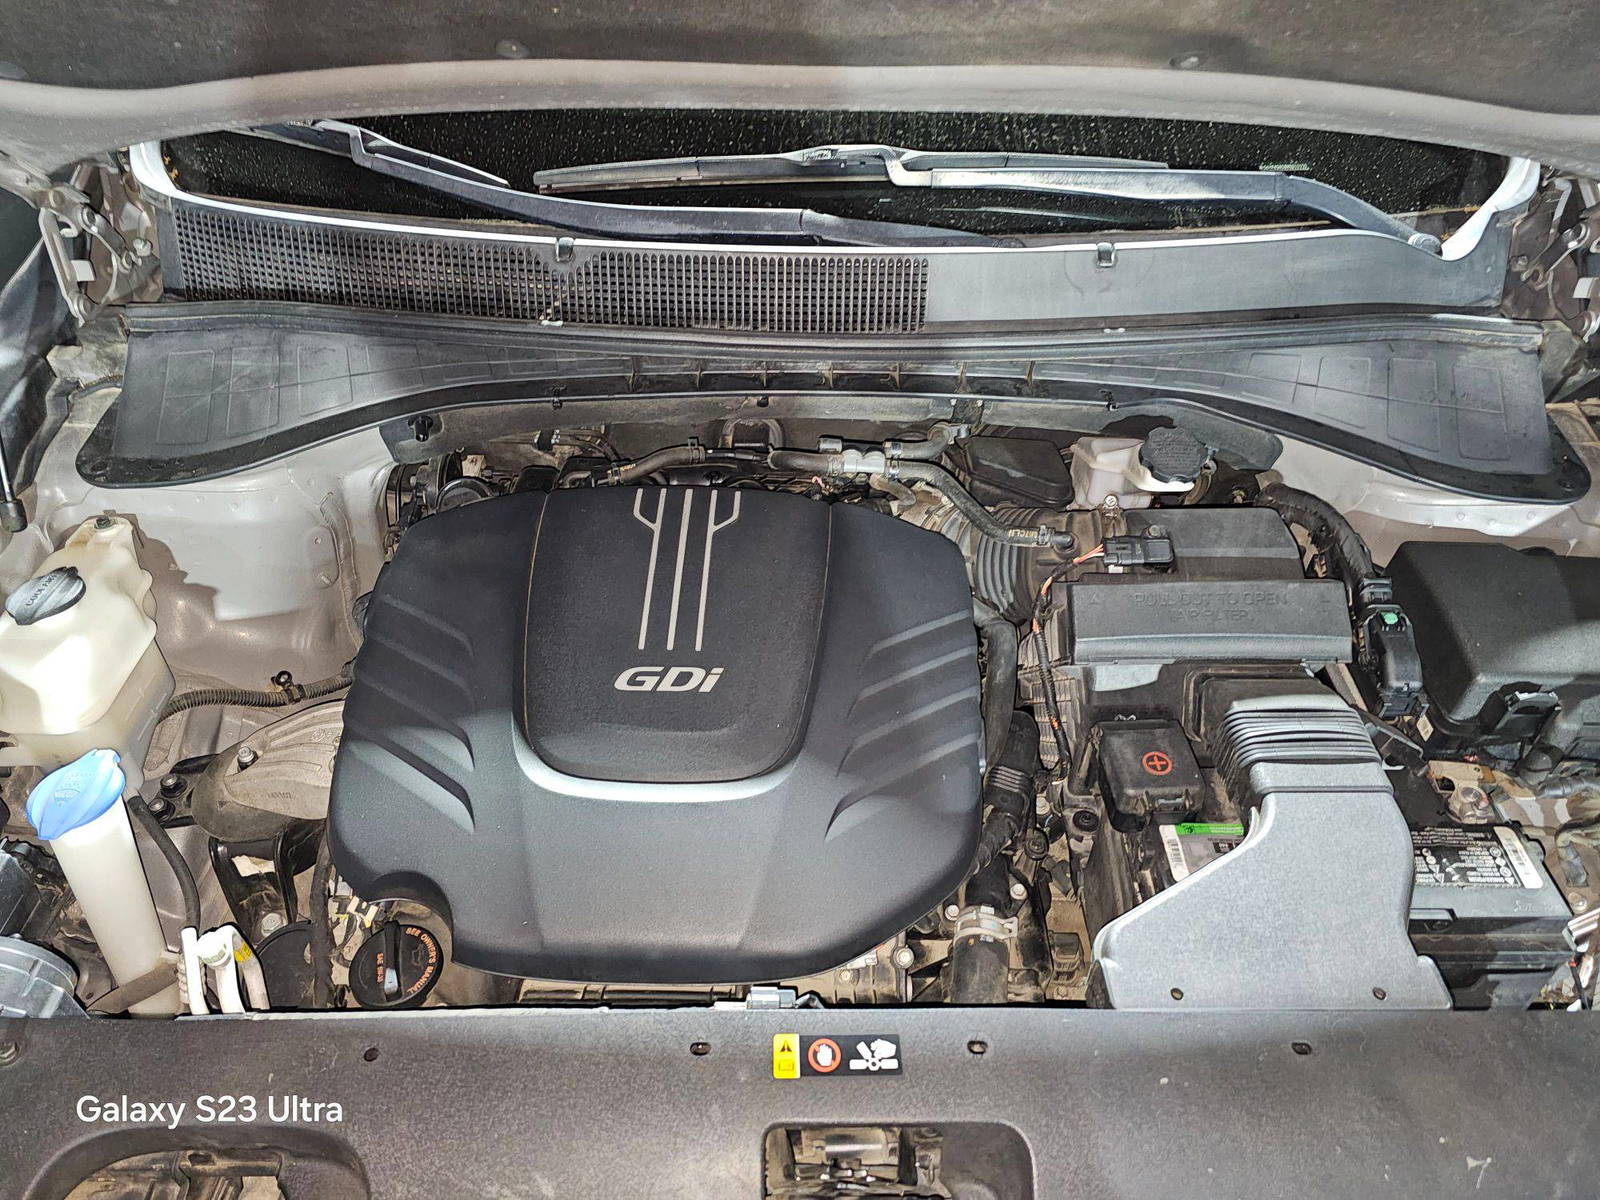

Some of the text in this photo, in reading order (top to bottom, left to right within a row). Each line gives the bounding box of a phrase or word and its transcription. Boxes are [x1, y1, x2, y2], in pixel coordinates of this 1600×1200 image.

[1216, 591, 1239, 606] TO
[1243, 591, 1288, 606] OPEN
[613, 666, 724, 693] GDi
[406, 928, 421, 937] SEE
[407, 965, 434, 994] MANUAL
